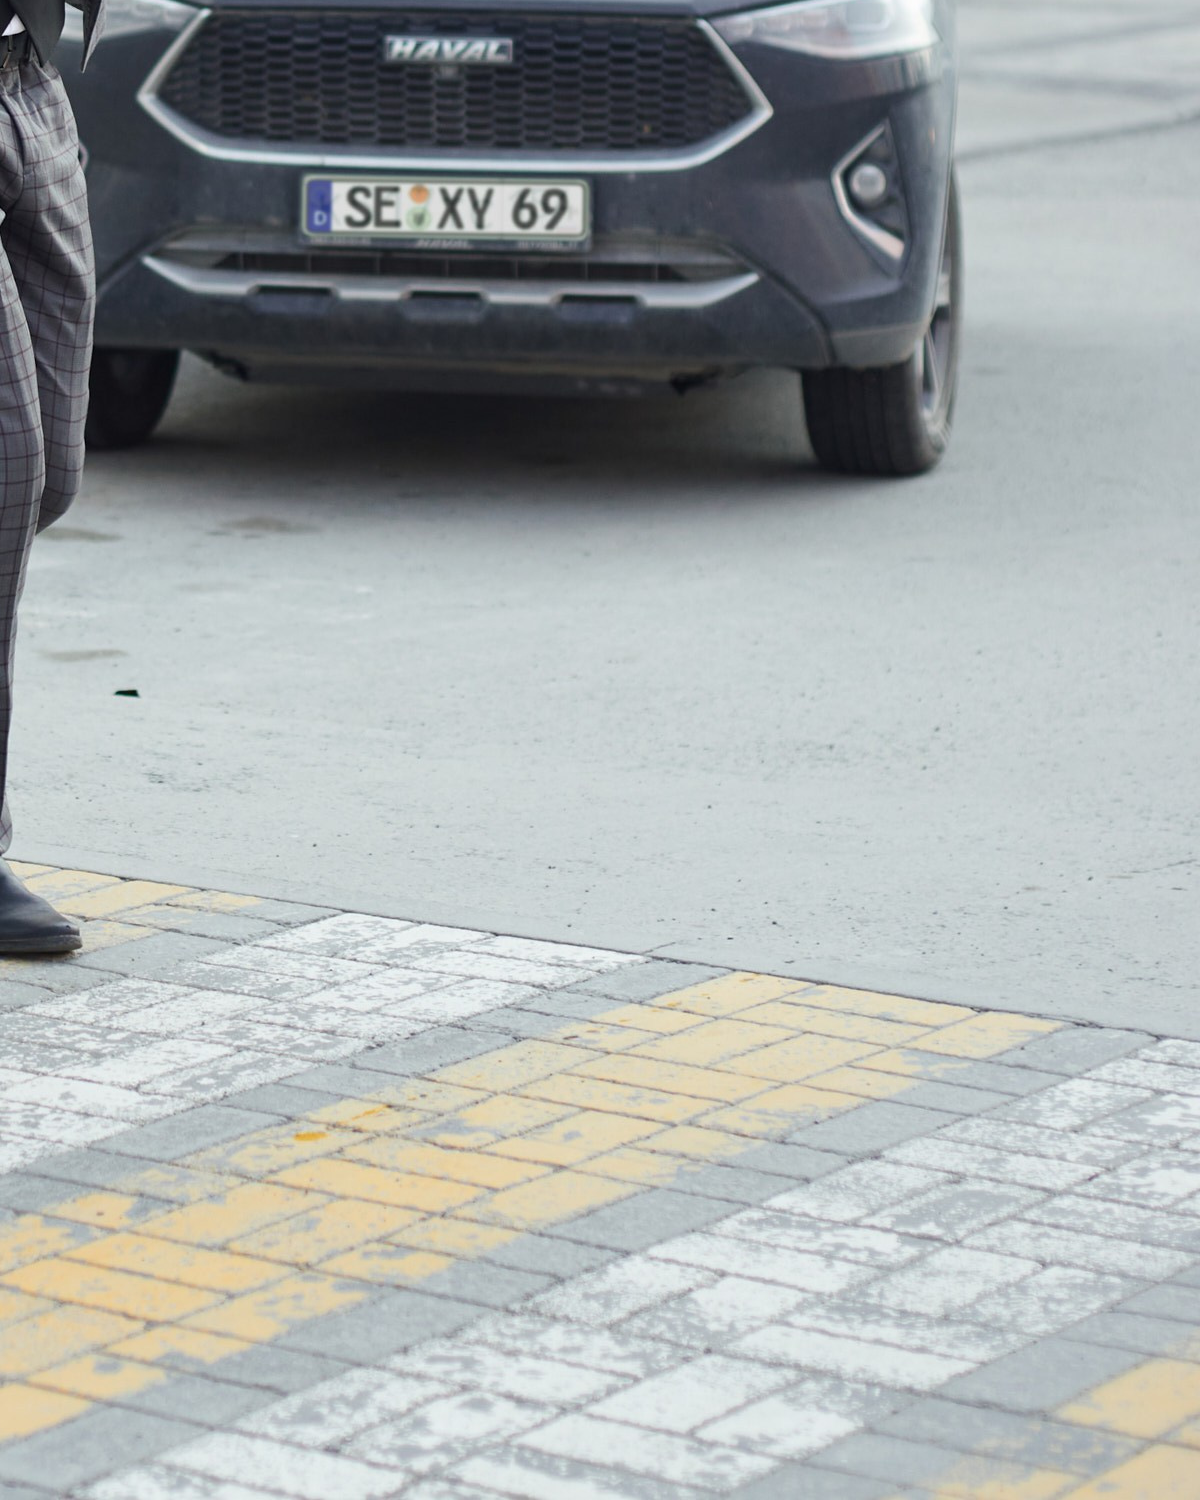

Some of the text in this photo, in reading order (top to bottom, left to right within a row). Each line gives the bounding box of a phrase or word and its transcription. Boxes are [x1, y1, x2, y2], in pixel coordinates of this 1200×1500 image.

[390, 38, 509, 61] HAVAL
[314, 211, 327, 226] D
[345, 186, 569, 231] SE XY 69
